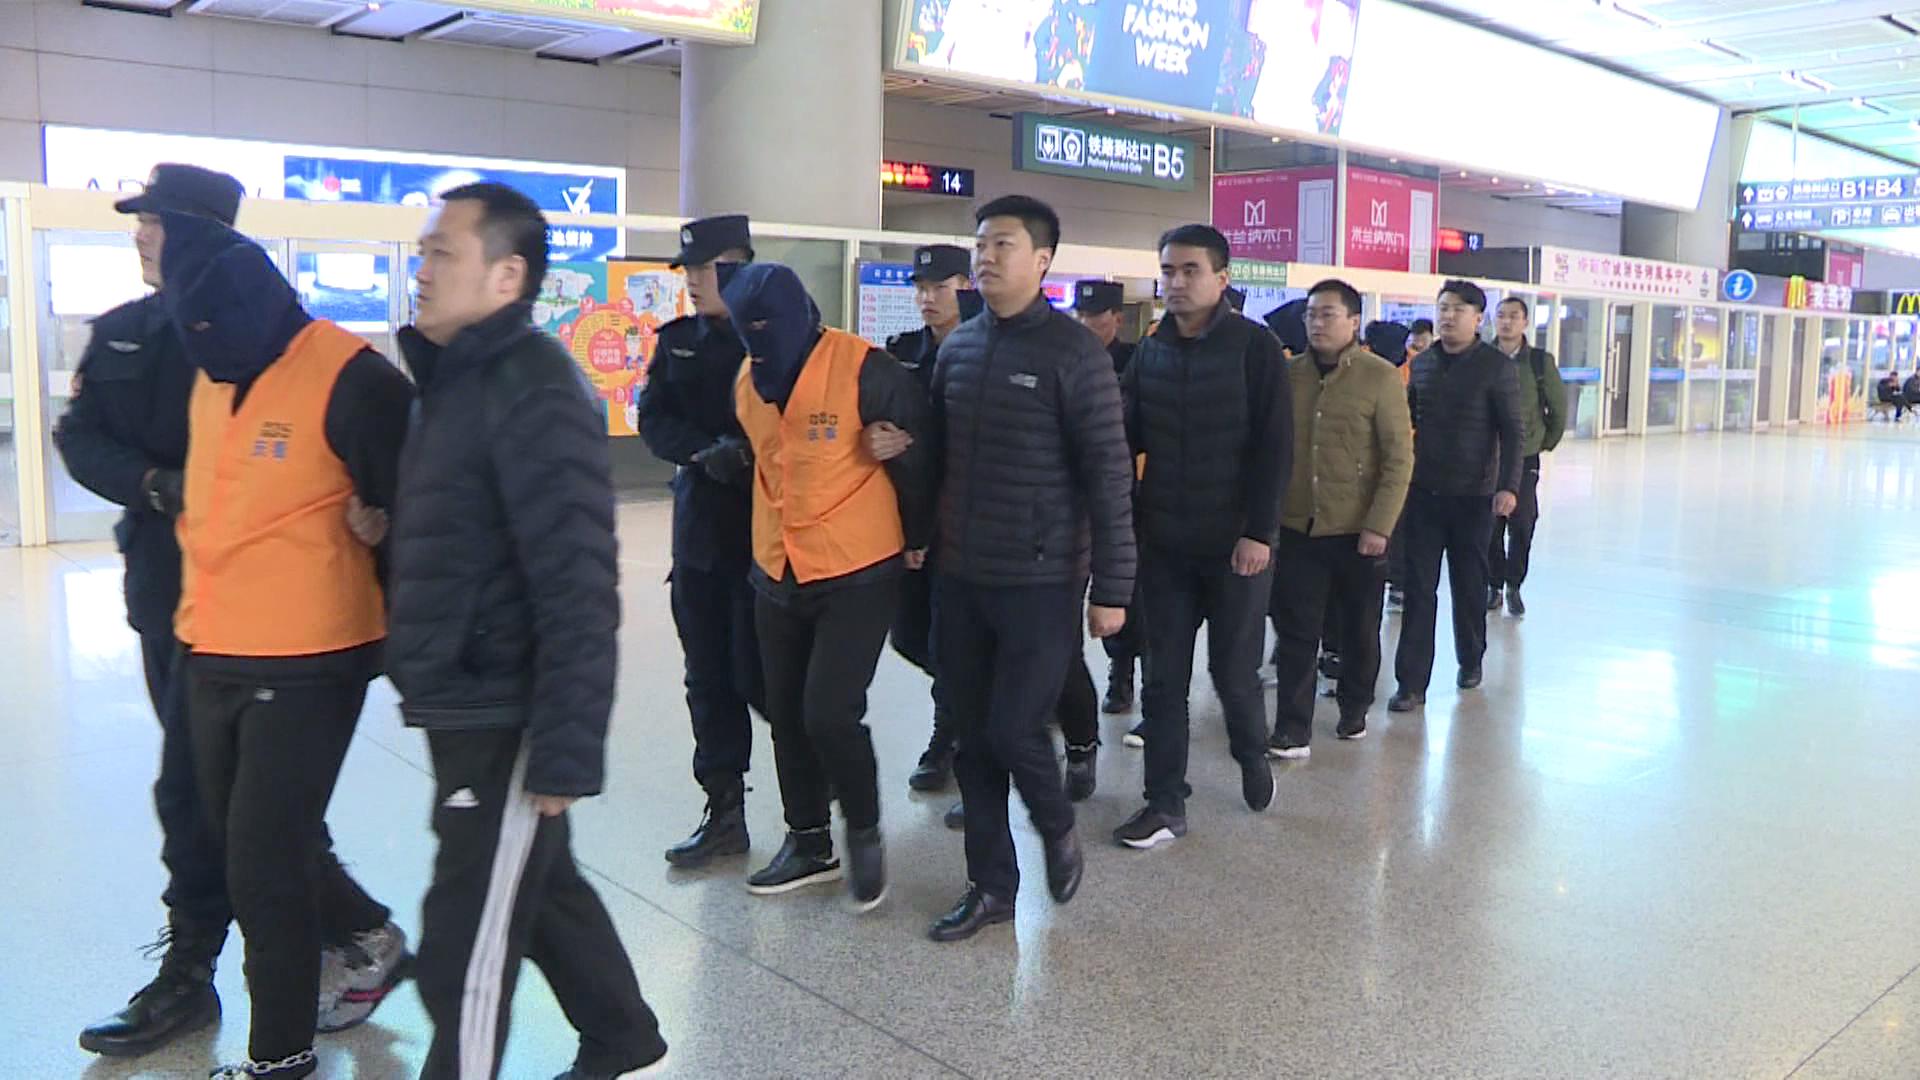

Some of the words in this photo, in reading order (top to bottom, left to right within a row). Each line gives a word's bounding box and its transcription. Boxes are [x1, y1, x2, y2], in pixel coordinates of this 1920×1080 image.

[1122, 3, 1210, 51] FASHION
[1135, 37, 1192, 75] WEEK
[1087, 134, 1151, 162] 铁路到达口
[1153, 143, 1185, 180] B5
[943, 171, 961, 192] 14
[1841, 177, 1903, 199] B1-B4
[1351, 225, 1405, 249] 米兰纳木门
[1468, 234, 1479, 251] 12
